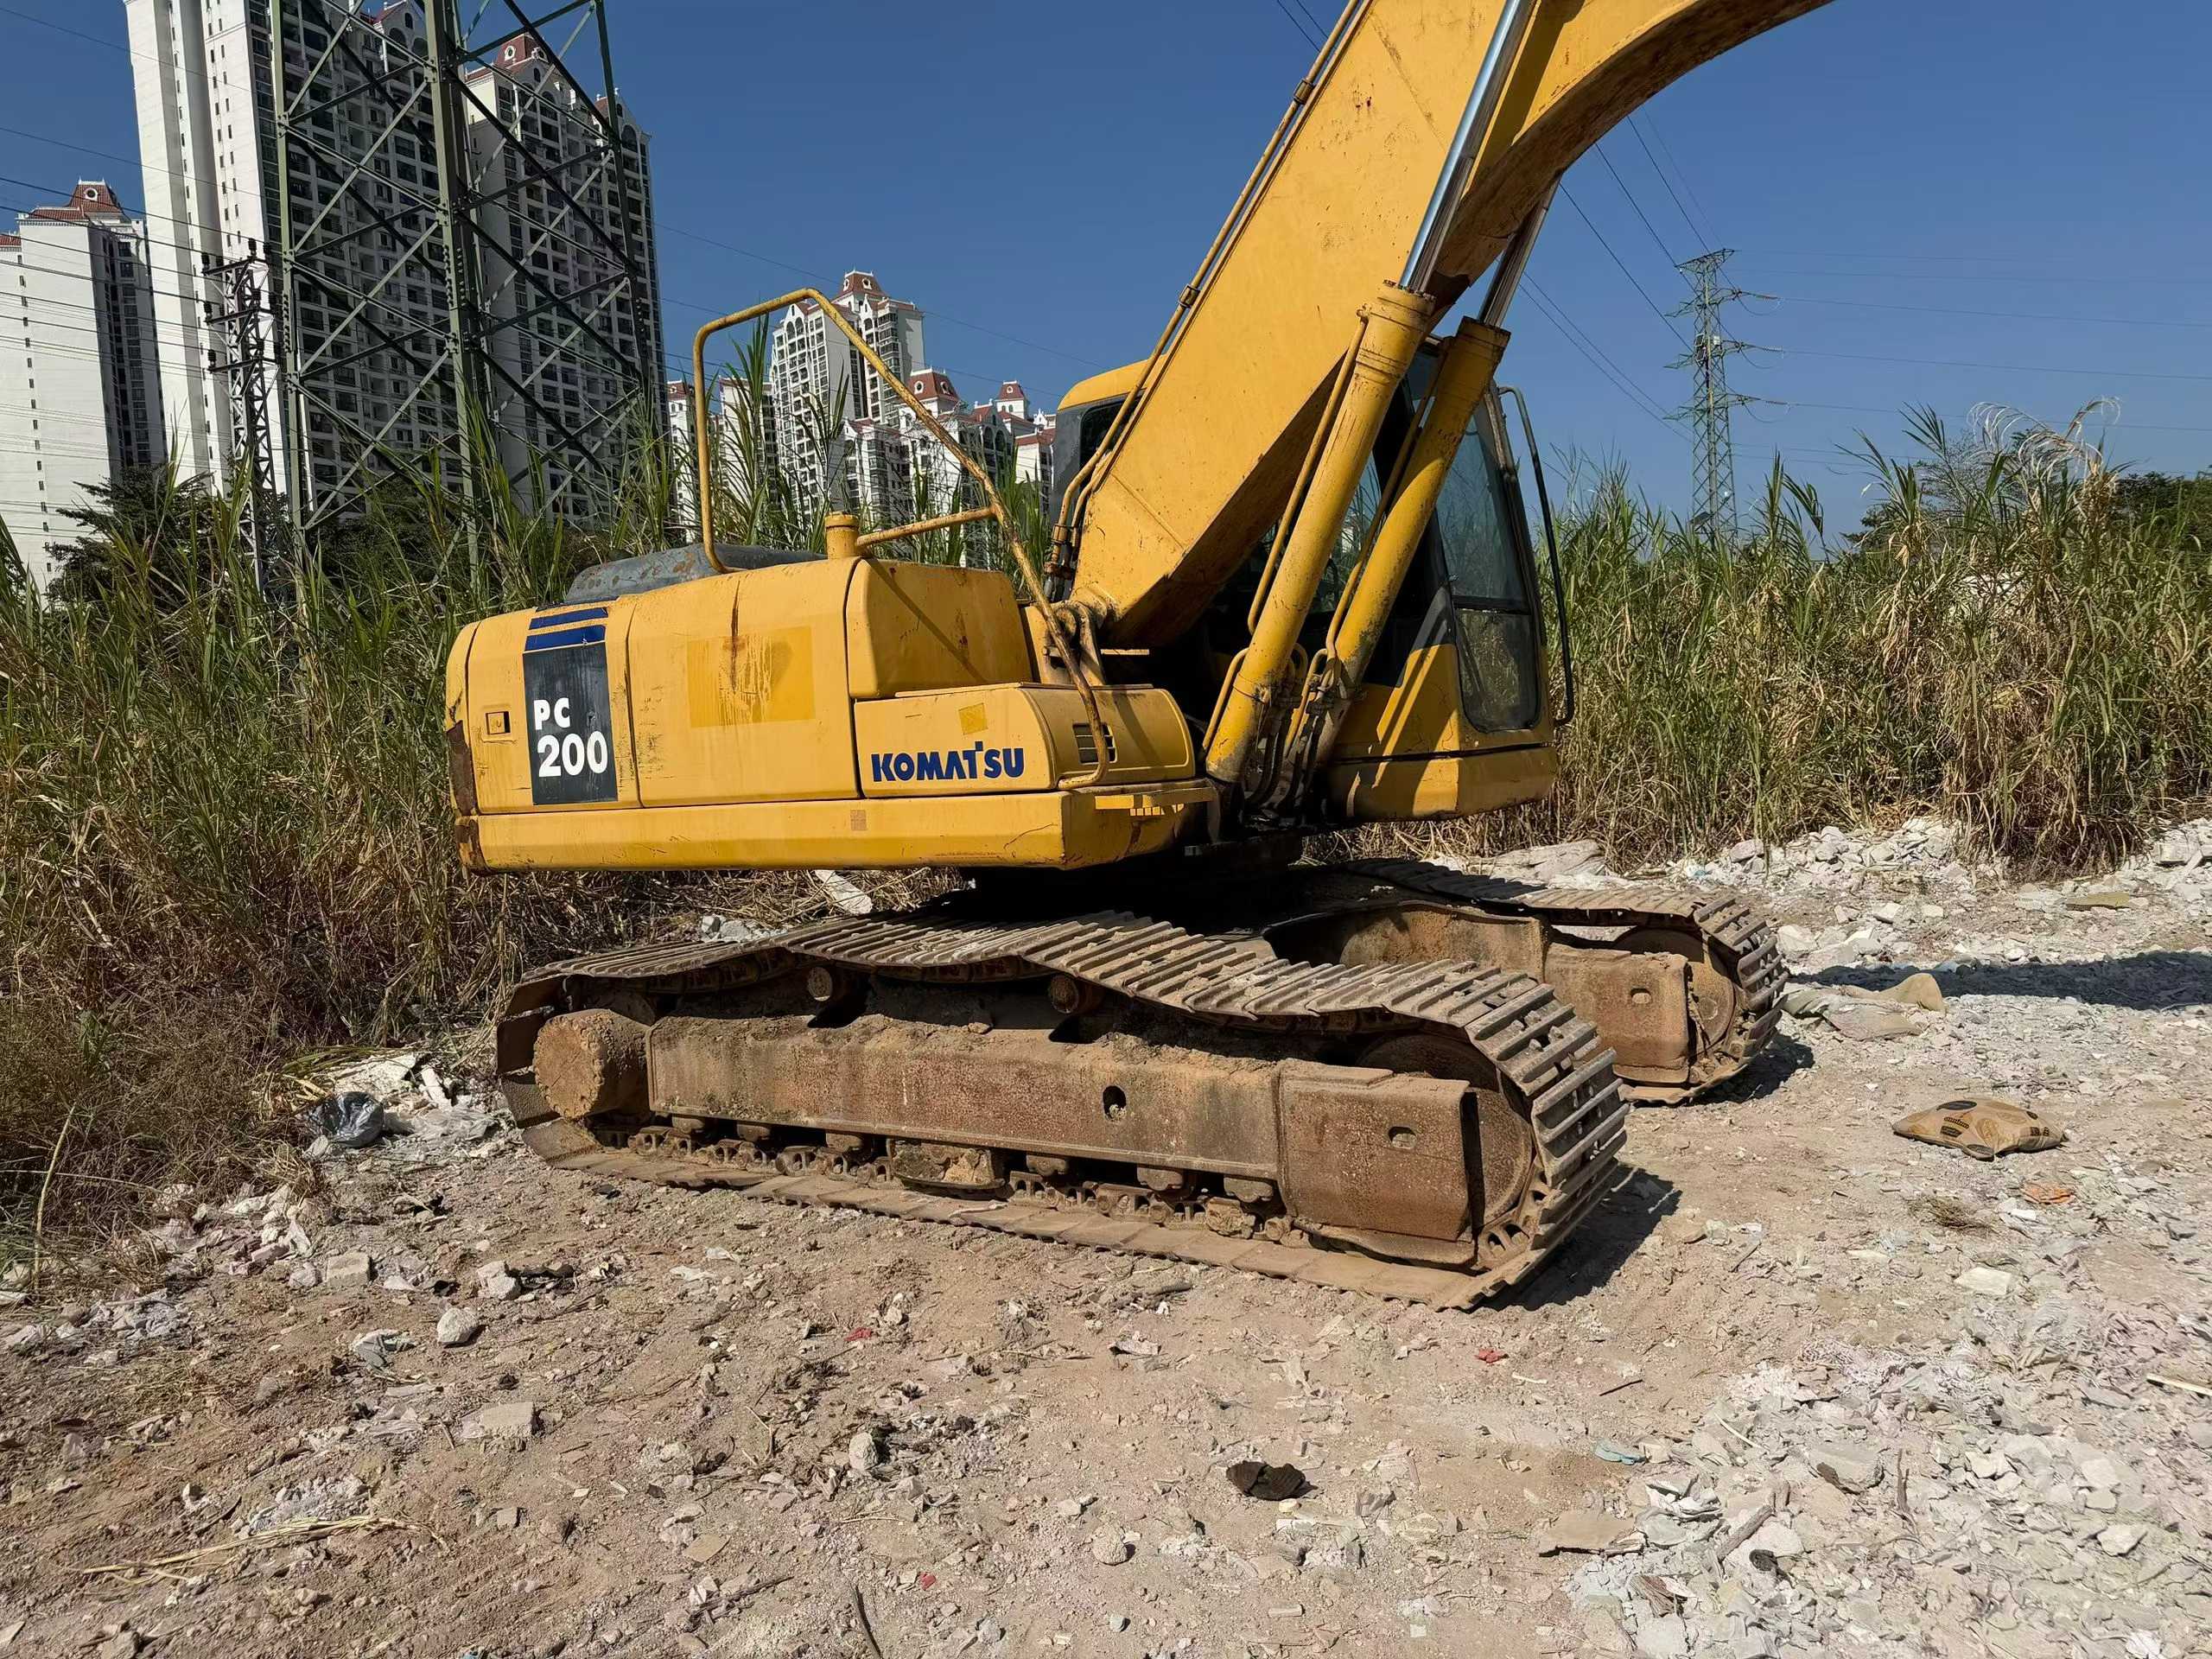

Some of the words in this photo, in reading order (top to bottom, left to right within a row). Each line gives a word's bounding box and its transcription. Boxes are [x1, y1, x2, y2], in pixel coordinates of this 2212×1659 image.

[533, 697, 570, 730] PC
[537, 731, 608, 777] 200
[871, 741, 1025, 782] KOMATSU
